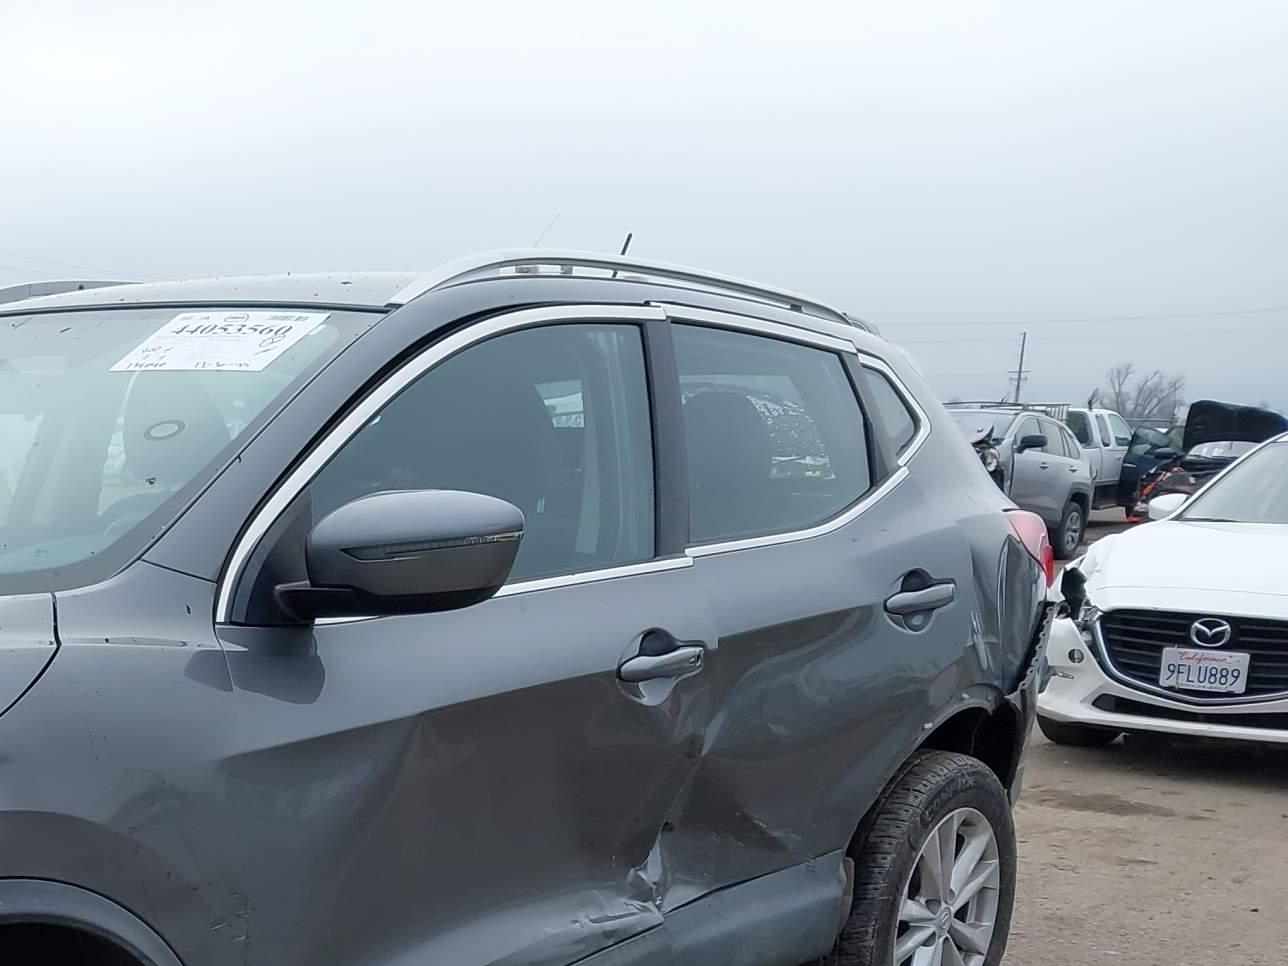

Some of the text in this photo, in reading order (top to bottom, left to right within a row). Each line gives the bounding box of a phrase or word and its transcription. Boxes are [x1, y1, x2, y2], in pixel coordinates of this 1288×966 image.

[171, 324, 293, 335] 44053560
[1178, 651, 1233, 665] California
[1165, 663, 1241, 687] 9FLU889
